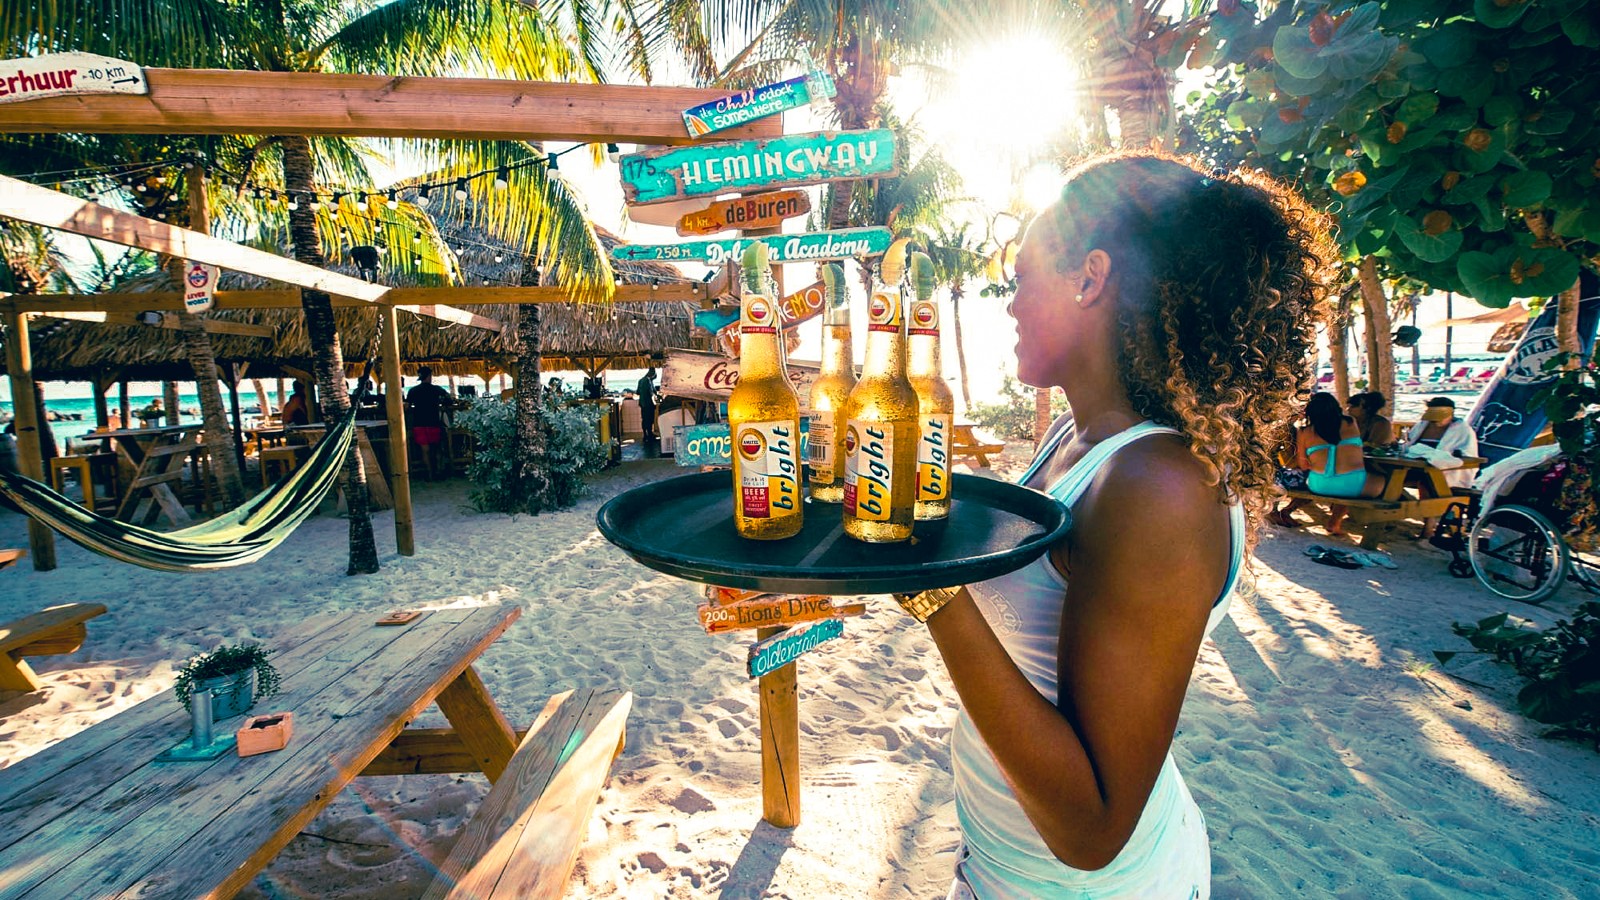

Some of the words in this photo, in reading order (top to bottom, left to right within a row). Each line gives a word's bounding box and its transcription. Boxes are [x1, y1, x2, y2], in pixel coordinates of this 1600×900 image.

[105, 67, 126, 79] km
[717, 88, 757, 113] Chill
[627, 159, 656, 180] 175
[682, 140, 878, 186] HEMINGWAY
[684, 216, 693, 231] 4
[726, 197, 798, 224] deBuren
[656, 247, 680, 259] 250
[785, 235, 871, 260] Academy
[769, 425, 796, 511] bright
[859, 425, 890, 516] bright
[922, 418, 946, 496] bright
[744, 488, 765, 496] BEER
[704, 610, 728, 623] 200
[737, 605, 782, 625] Lions
[787, 597, 830, 617] Dive
